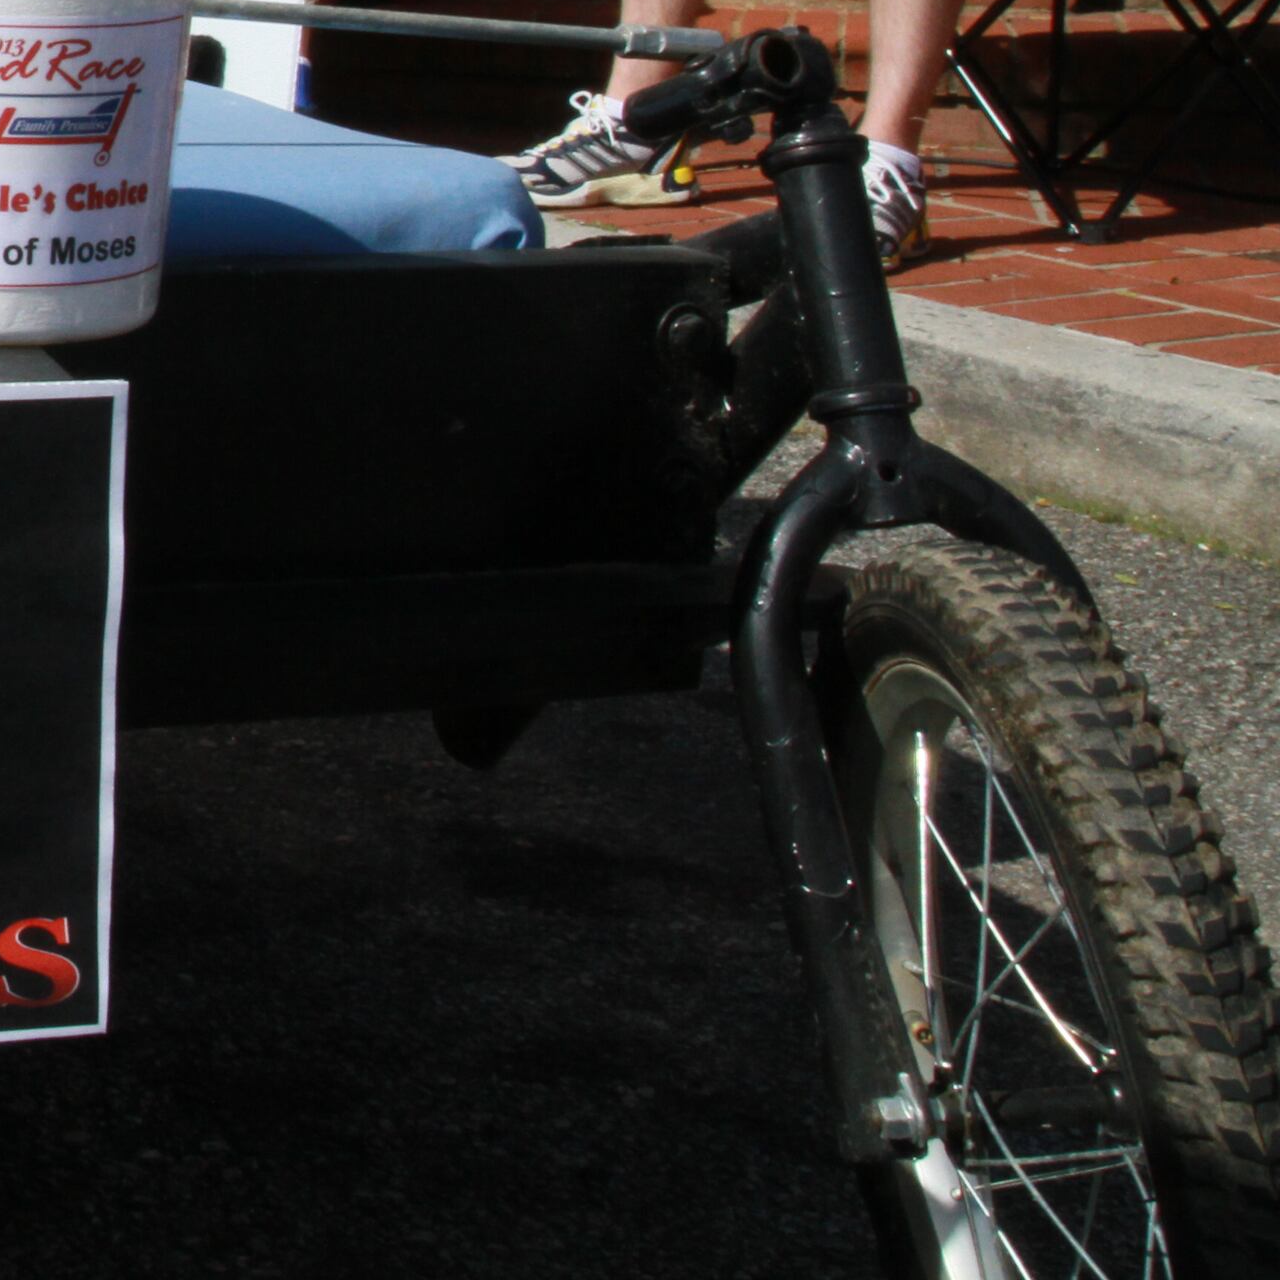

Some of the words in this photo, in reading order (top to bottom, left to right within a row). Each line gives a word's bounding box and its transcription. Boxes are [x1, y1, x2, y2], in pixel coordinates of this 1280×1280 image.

[46, 38, 147, 91] Race
[65, 179, 149, 213] Choice
[2, 237, 39, 266] of
[49, 234, 136, 266] Moses
